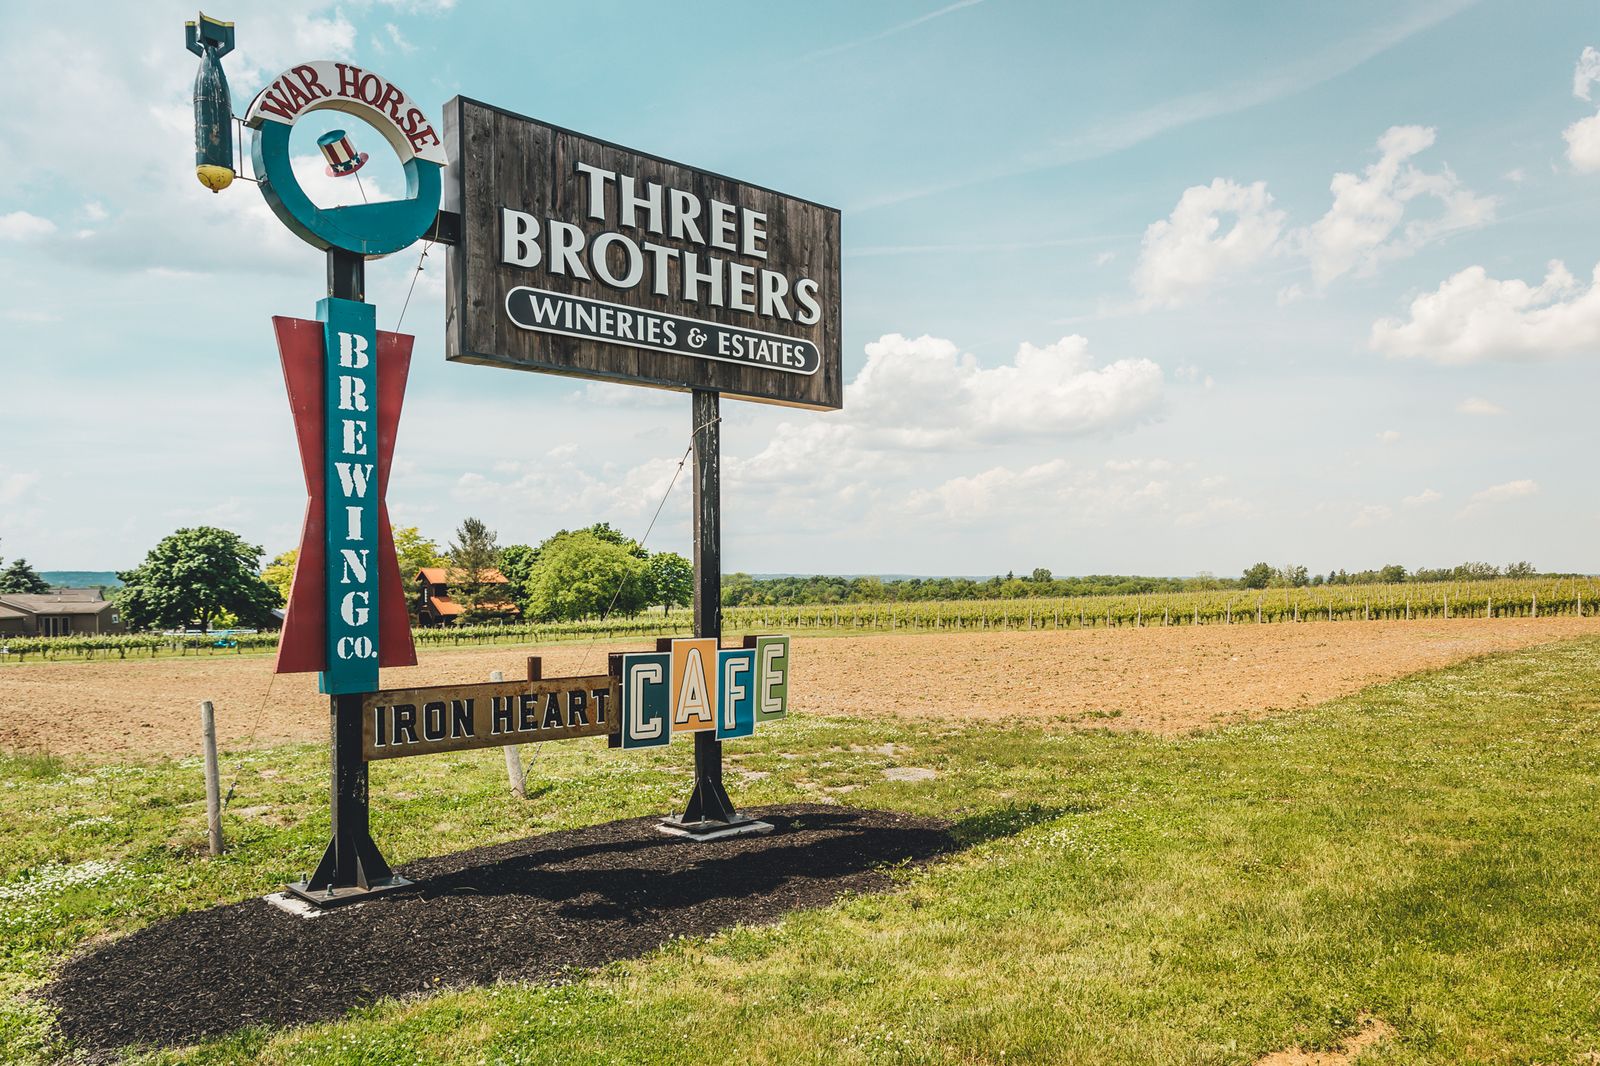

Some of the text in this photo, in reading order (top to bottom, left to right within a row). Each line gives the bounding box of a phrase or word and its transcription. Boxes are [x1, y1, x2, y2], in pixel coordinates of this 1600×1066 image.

[260, 63, 440, 153] WAR HORSE
[576, 161, 767, 260] THREE
[501, 207, 821, 325] BROTHERS
[529, 294, 805, 368] WINERIES & ESTATES
[334, 332, 374, 627] BREWING
[337, 636, 378, 659] CO.
[629, 643, 786, 741] CAFE
[374, 687, 610, 747] IRON HEART
